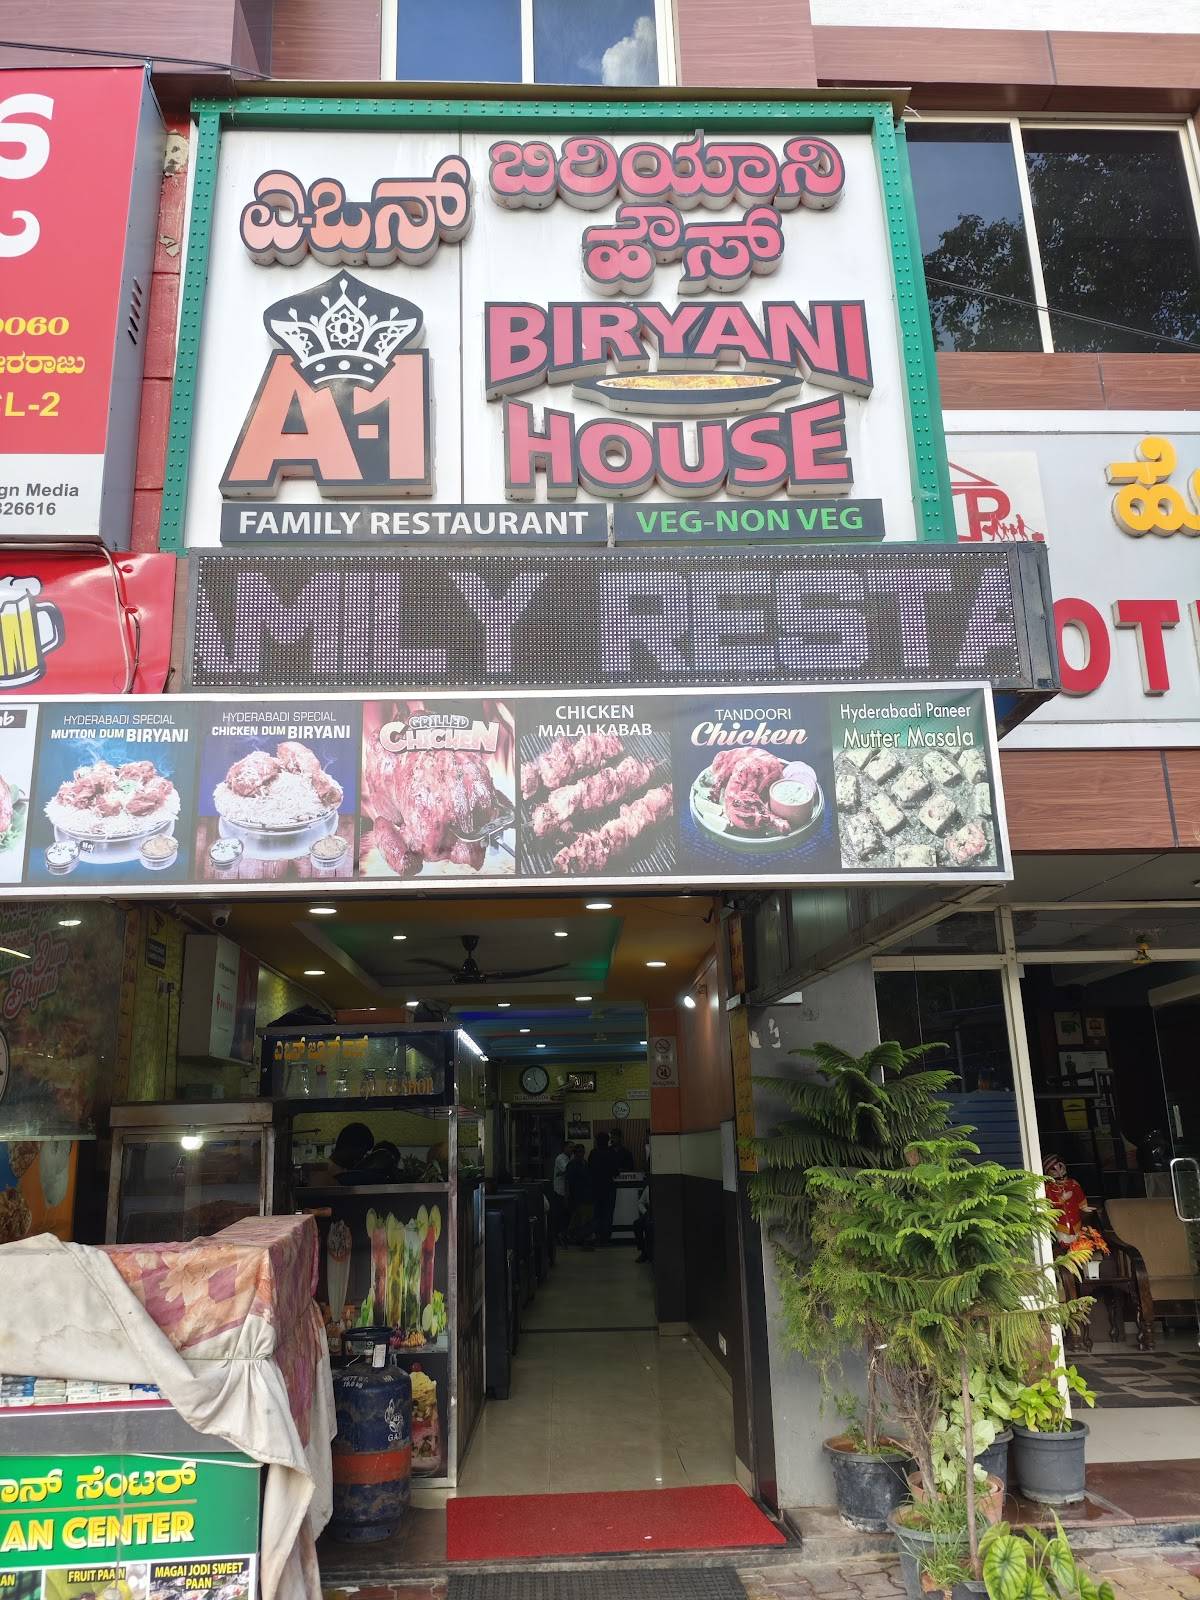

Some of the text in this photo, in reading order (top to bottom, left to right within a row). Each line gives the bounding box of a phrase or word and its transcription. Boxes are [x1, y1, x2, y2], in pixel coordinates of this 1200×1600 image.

[488, 132, 845, 205] ಬಿರಿಯಾನಿ
[582, 202, 784, 288] ಹೌಸ್
[0, 316, 70, 336] 060
[484, 300, 873, 392] BIRYANI
[0, 391, 61, 417] L-2
[503, 394, 854, 490] HOUSE
[25, 482, 79, 497] Media
[239, 510, 590, 535] FAMILY RESTAURANT
[636, 507, 864, 534] VEG-NON VEG
[63, 714, 176, 726] HYDERABADI SPECIAL
[222, 711, 337, 723] HYDERABADI SPECIAL
[409, 714, 470, 729] GRILLED
[555, 704, 635, 720] CHICKEN
[714, 708, 792, 721] TANDOORI
[840, 701, 972, 723] Hyderabadi Paneer
[51, 728, 189, 743] MUTTON DUM BIRYANI
[211, 724, 351, 740] CHICKEN DUM BIRYANI
[379, 719, 501, 753] CHICKEN
[537, 723, 653, 738] MALAI KABAB
[691, 720, 809, 747] Chicken
[842, 725, 975, 749] Mutter Masala
[76, 1460, 198, 1501] ಸೆಂಟರ್
[62, 1510, 196, 1551] CENTER
[68, 1570, 96, 1583] FRUIT
[155, 1566, 187, 1578] MAGAI
[188, 1564, 211, 1576] JODI
[212, 1561, 244, 1575] SWEET
[185, 1577, 212, 1590] PAAN
